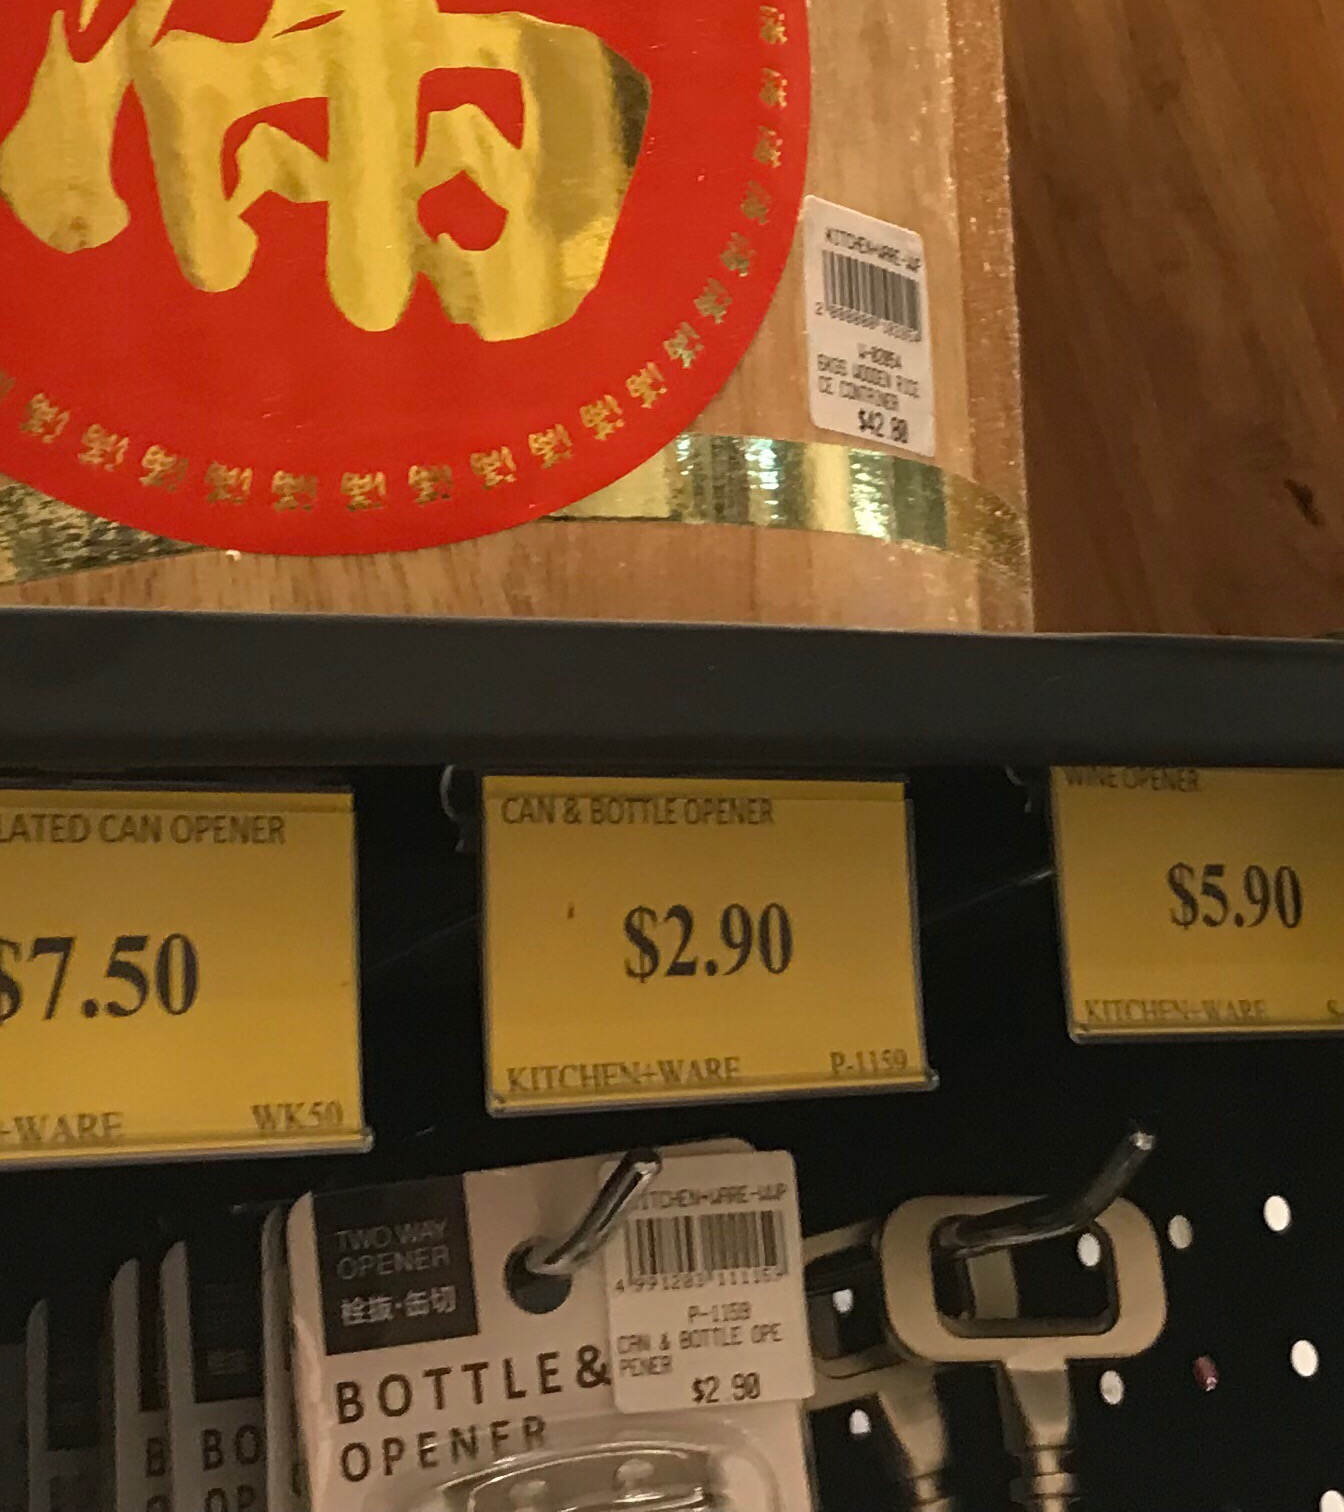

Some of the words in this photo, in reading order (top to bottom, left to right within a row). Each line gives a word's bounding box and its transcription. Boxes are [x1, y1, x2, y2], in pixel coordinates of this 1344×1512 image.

[501, 797, 555, 824] CAN
[563, 797, 581, 824] &
[589, 797, 678, 825] BOTTLE
[685, 798, 774, 825] OPENER
[98, 814, 162, 845] CAN
[170, 815, 286, 845] OPENER
[1167, 862, 1304, 930] $5.90
[623, 902, 794, 984] $2.90
[506, 1057, 741, 1094] KITCHEN+WARE
[251, 1100, 343, 1133] WK50
[335, 1226, 392, 1250] TWO
[394, 1218, 447, 1244] WAY
[337, 1245, 451, 1280] OPENER
[679, 1326, 743, 1349] BOTTLE
[340, 1415, 546, 1483] OPENER
